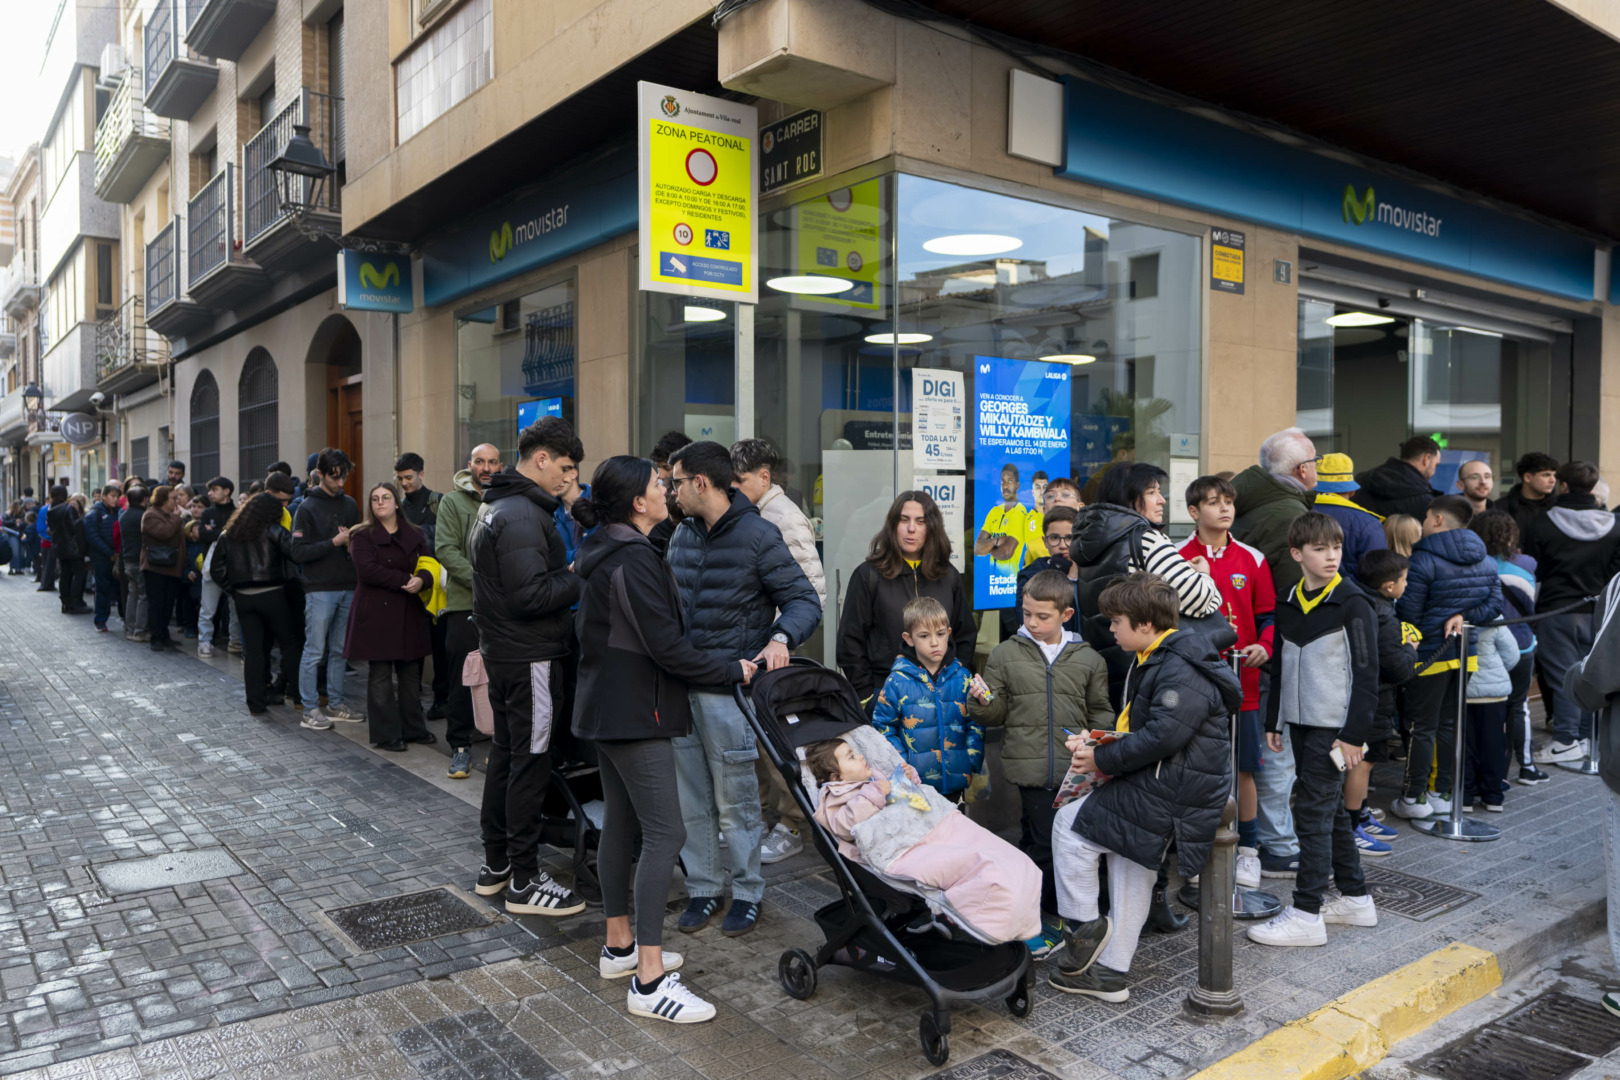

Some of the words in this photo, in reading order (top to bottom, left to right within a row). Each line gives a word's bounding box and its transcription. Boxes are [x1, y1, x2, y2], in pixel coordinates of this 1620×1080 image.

[777, 114, 818, 143] CARRER
[657, 124, 686, 139] ZONA
[690, 131, 744, 151] PEATONAL
[764, 161, 788, 187] SANT
[796, 151, 816, 175] ROC
[656, 183, 691, 194] AUTORIZADO
[692, 188, 711, 197] CARGA
[717, 193, 745, 203] DESCARGA
[656, 198, 681, 206] EXCEPTO
[683, 202, 712, 212] DOMINGOS
[687, 210, 722, 221] RESIDENTES
[1378, 202, 1442, 237] movistar
[516, 204, 569, 245] movistar
[678, 230, 688, 238] 10
[1280, 264, 1285, 281] 9
[360, 294, 400, 303] movistar
[923, 380, 955, 397] DIGI
[980, 400, 1028, 414] GEORGES
[980, 412, 1044, 427] MIKAUTADZE
[1046, 416, 1053, 427] Y
[67, 422, 93, 435] NP
[980, 424, 1010, 436] WILLY
[1011, 426, 1067, 440] KAMBWALA
[921, 434, 938, 442] TODA
[988, 438, 1024, 447] ESPERAMOS
[925, 444, 940, 456] 45
[923, 485, 955, 501] DIGI
